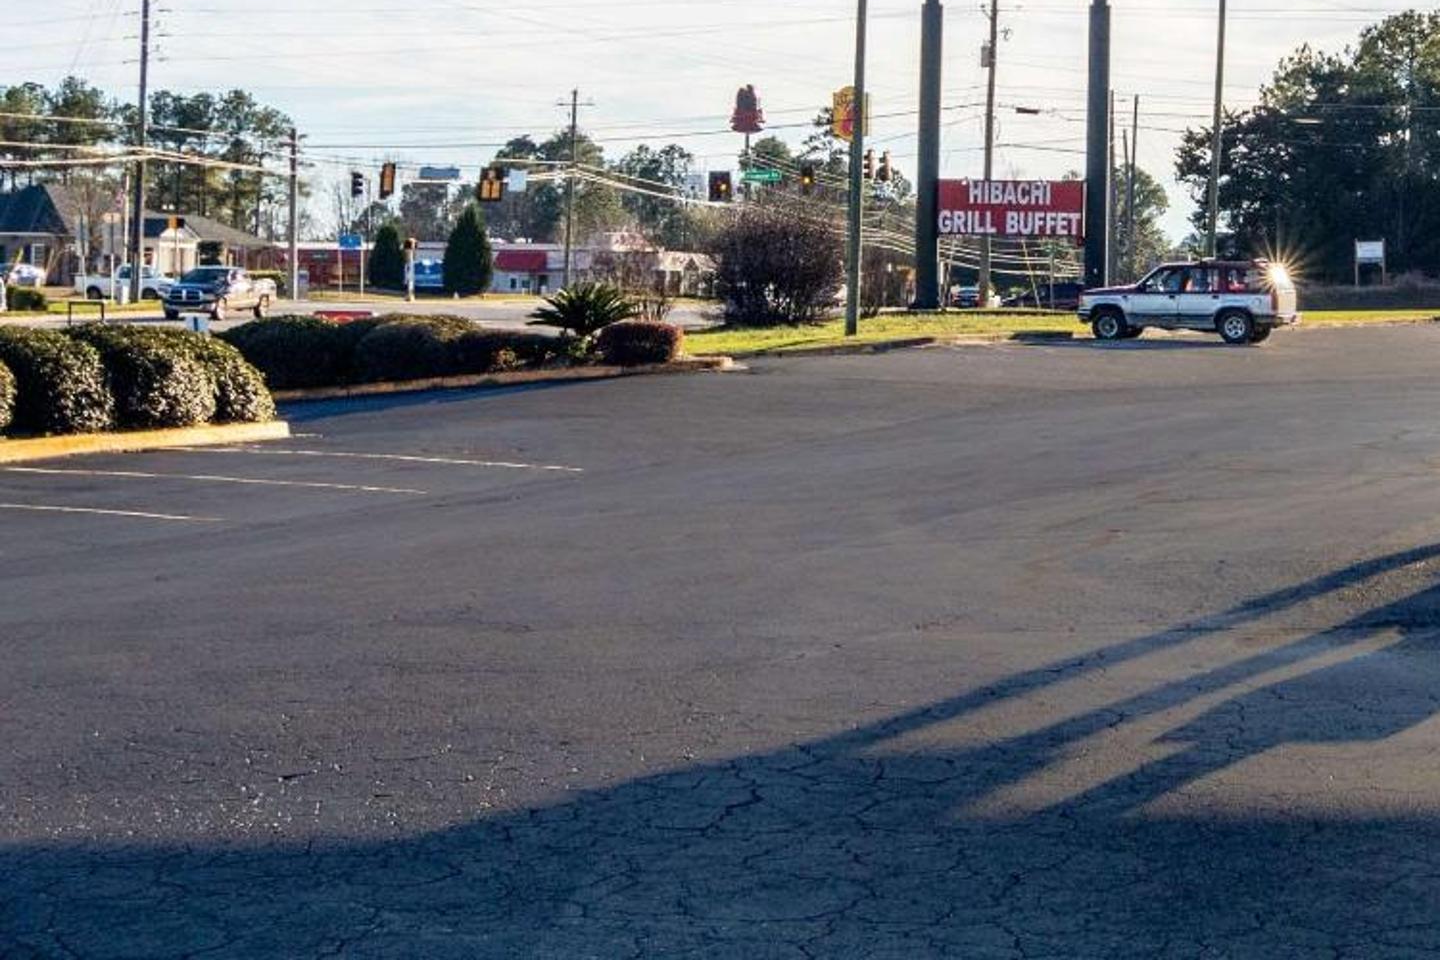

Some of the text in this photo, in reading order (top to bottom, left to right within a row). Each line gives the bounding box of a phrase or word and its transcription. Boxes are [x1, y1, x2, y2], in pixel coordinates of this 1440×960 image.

[968, 181, 1051, 205] HIBACHI
[938, 210, 1081, 235] GRILL BUFFET
